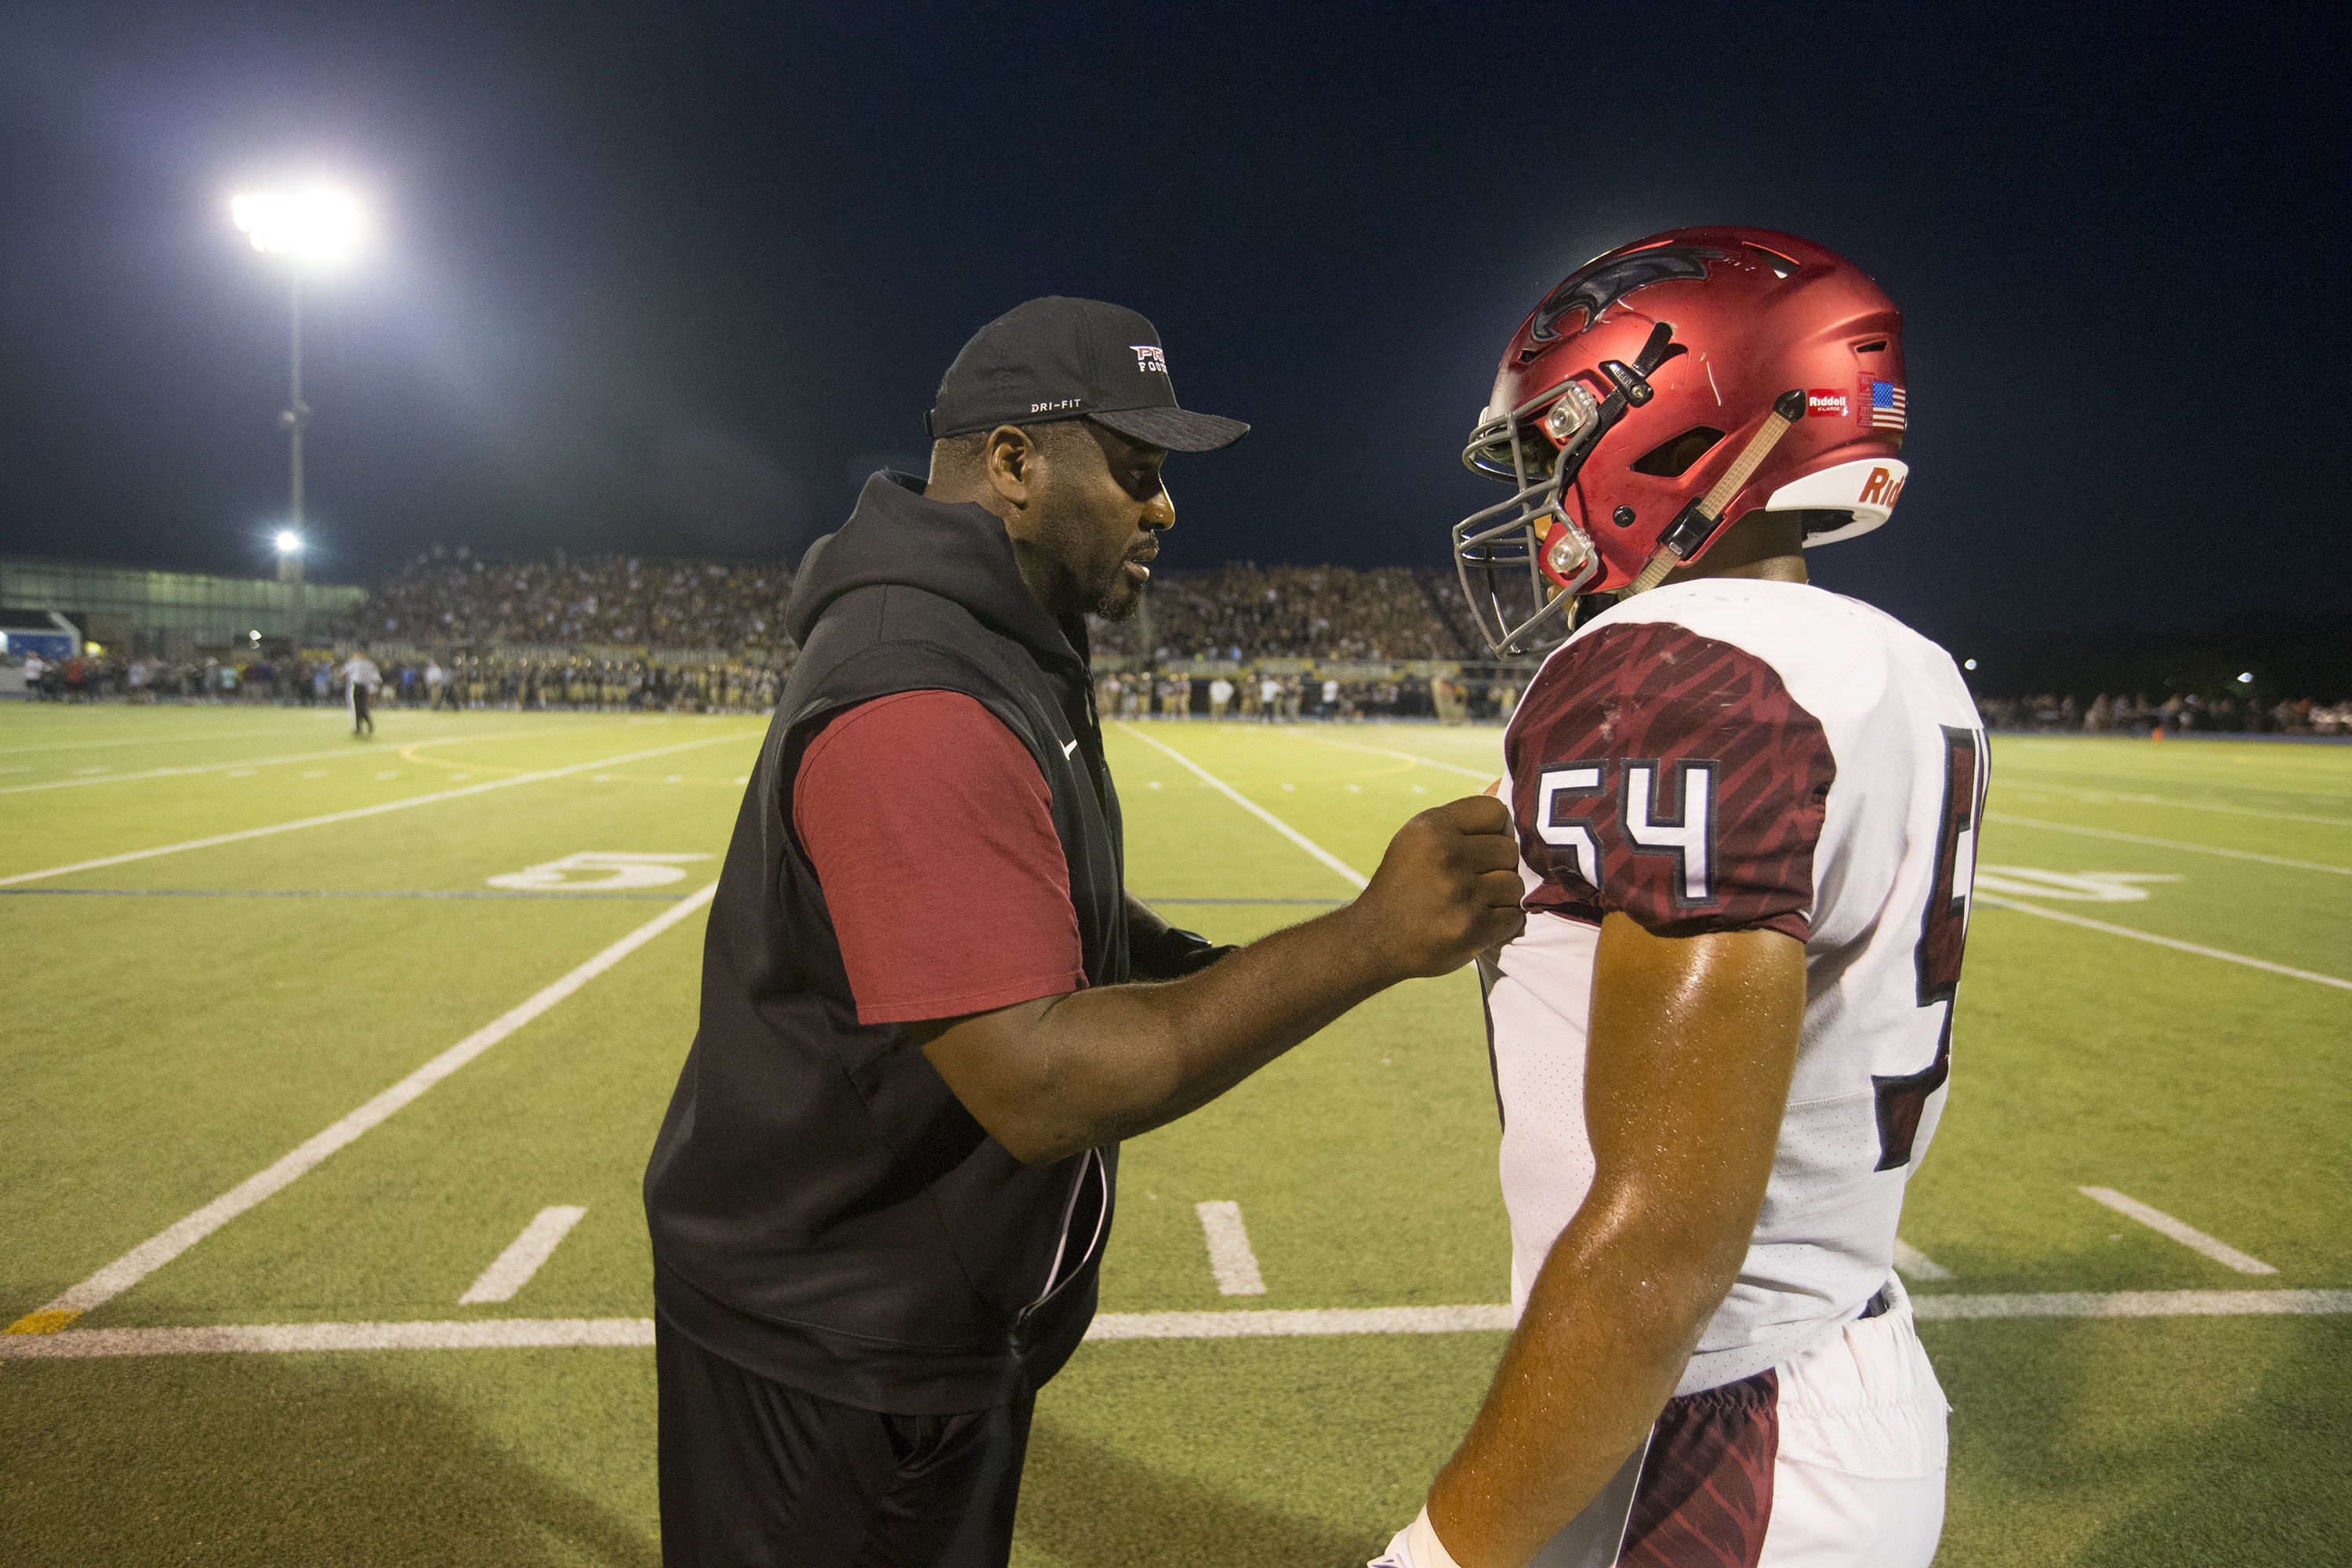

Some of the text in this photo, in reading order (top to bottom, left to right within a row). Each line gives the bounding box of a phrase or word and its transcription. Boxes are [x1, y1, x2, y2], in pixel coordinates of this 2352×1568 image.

[1031, 399, 1081, 412] DRI-FIT
[1809, 396, 1846, 406] Riddell
[1534, 757, 1720, 908] 54
